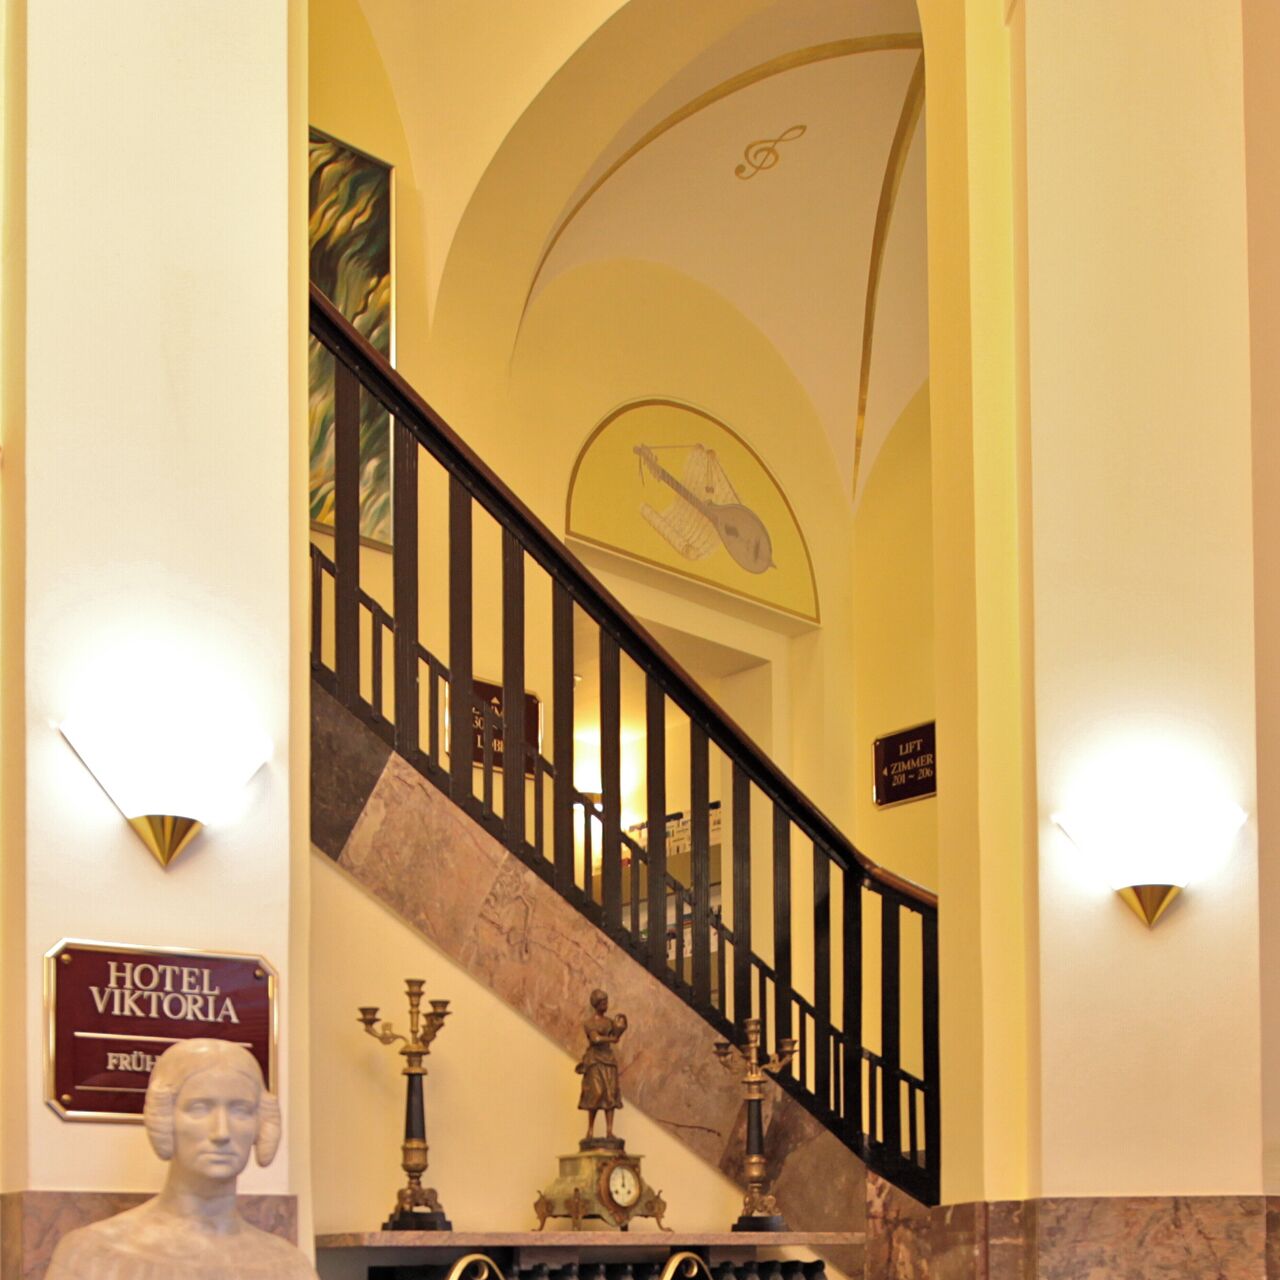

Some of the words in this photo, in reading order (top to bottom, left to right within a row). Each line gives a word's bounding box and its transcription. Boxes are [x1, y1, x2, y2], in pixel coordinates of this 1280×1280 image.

[899, 738, 923, 756] LIFT
[890, 753, 933, 775] ZIMMER
[106, 960, 221, 996] HOTEL
[89, 986, 240, 1024] VIKTORIA
[106, 1050, 159, 1073] FRÜH
